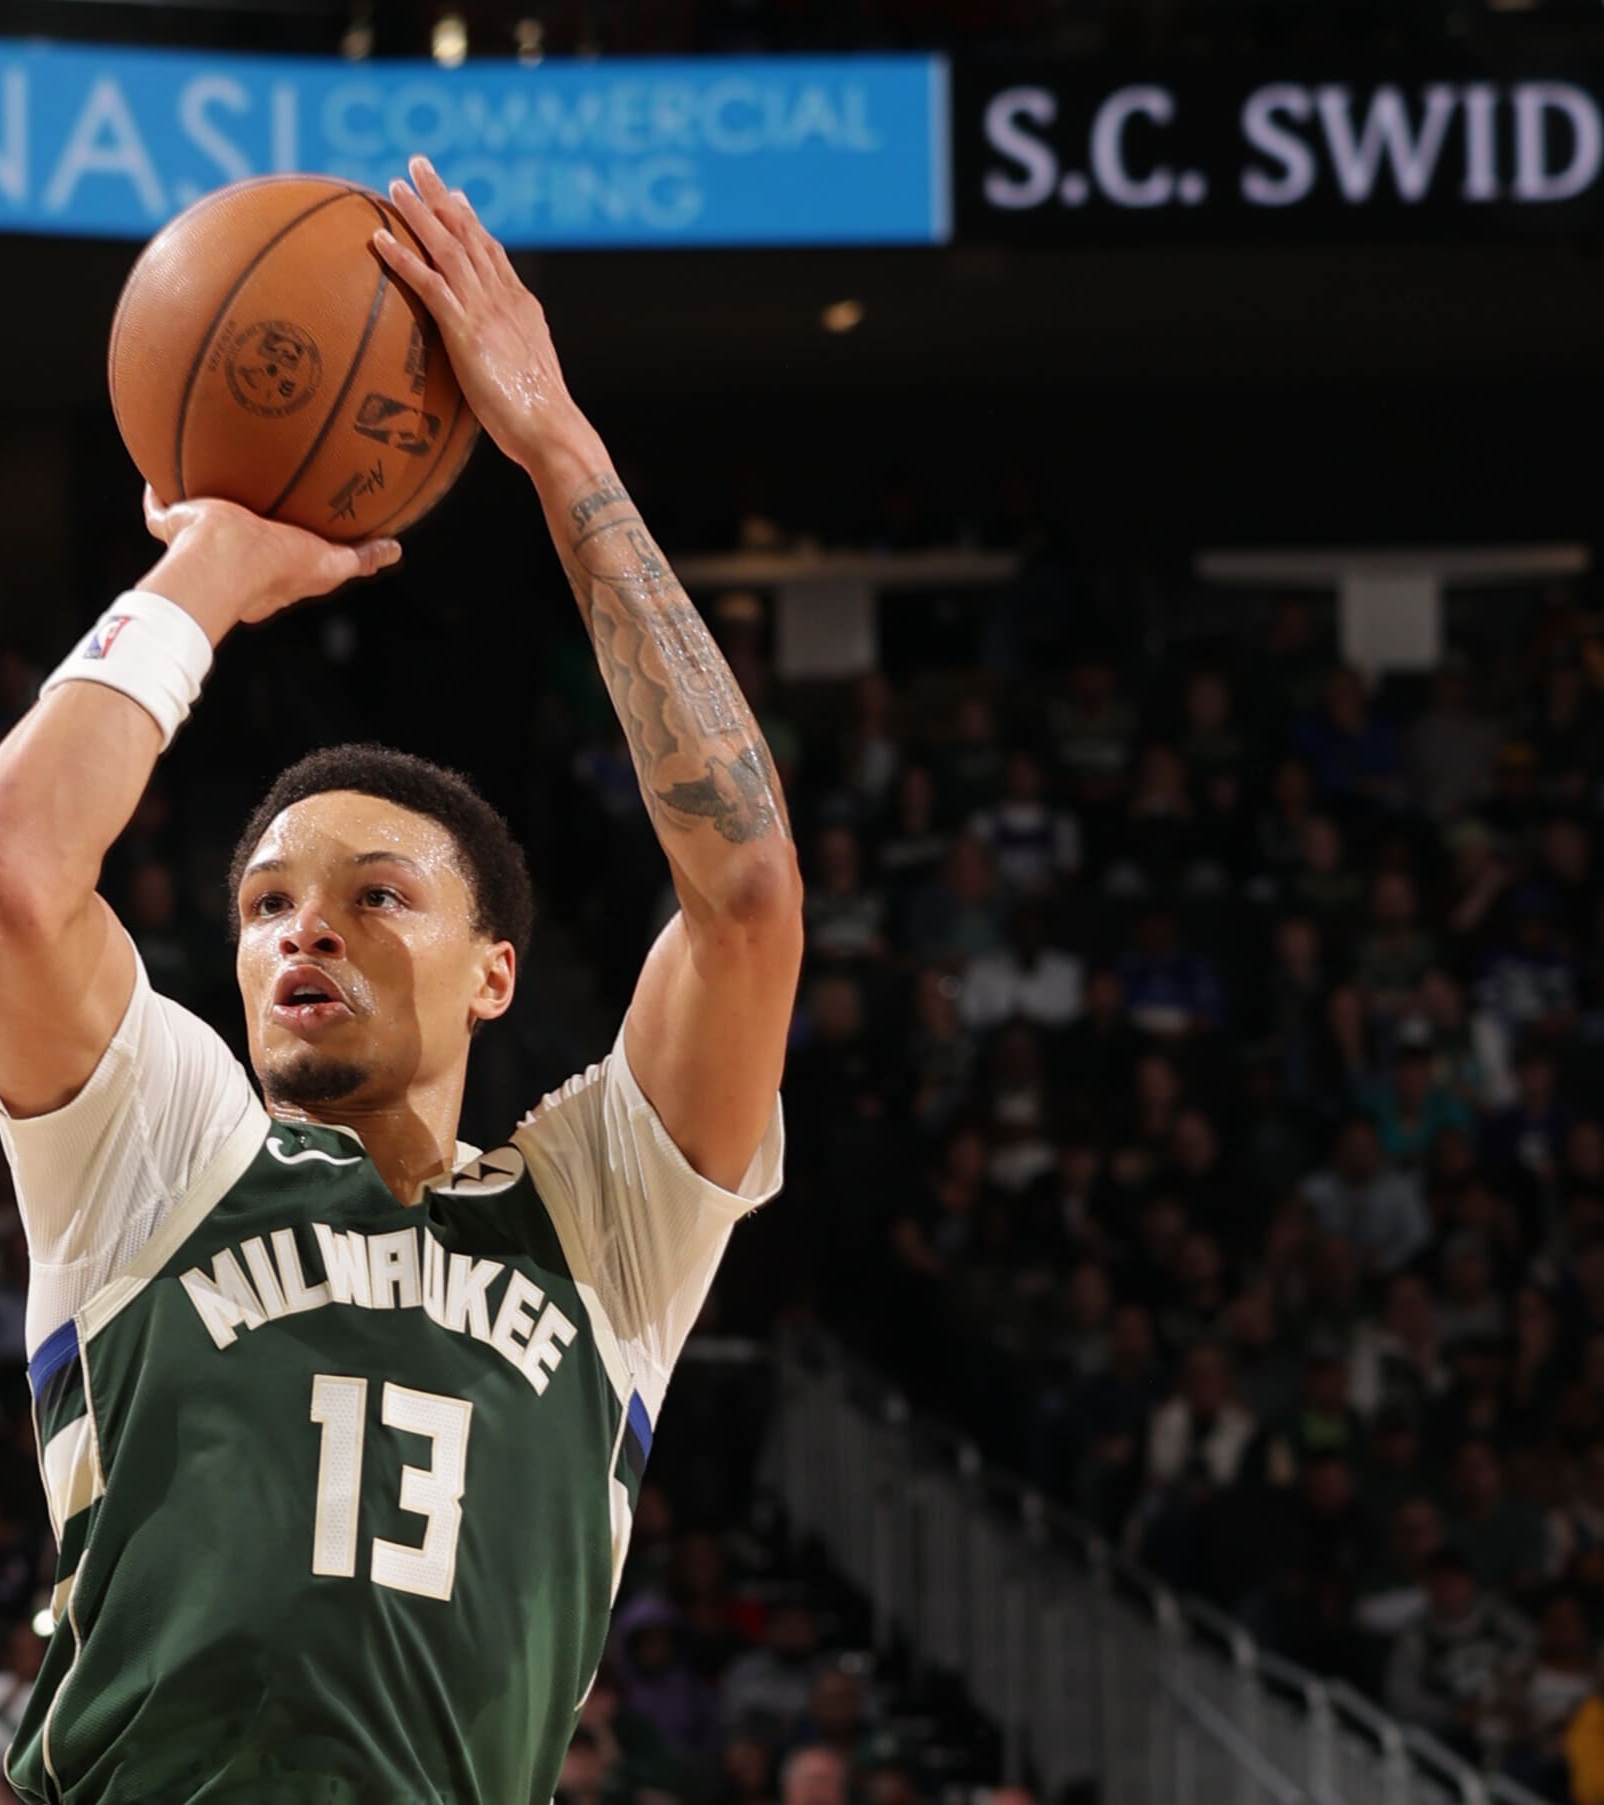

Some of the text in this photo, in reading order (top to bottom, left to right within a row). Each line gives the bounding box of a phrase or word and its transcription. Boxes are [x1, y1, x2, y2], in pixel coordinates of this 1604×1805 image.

[321, 80, 884, 155] COMMERCIAL
[984, 81, 1604, 208] S.C. SWID
[326, 155, 704, 230] OFING
[178, 1222, 578, 1396] MILWAUKEE
[309, 1373, 473, 1602] 13
